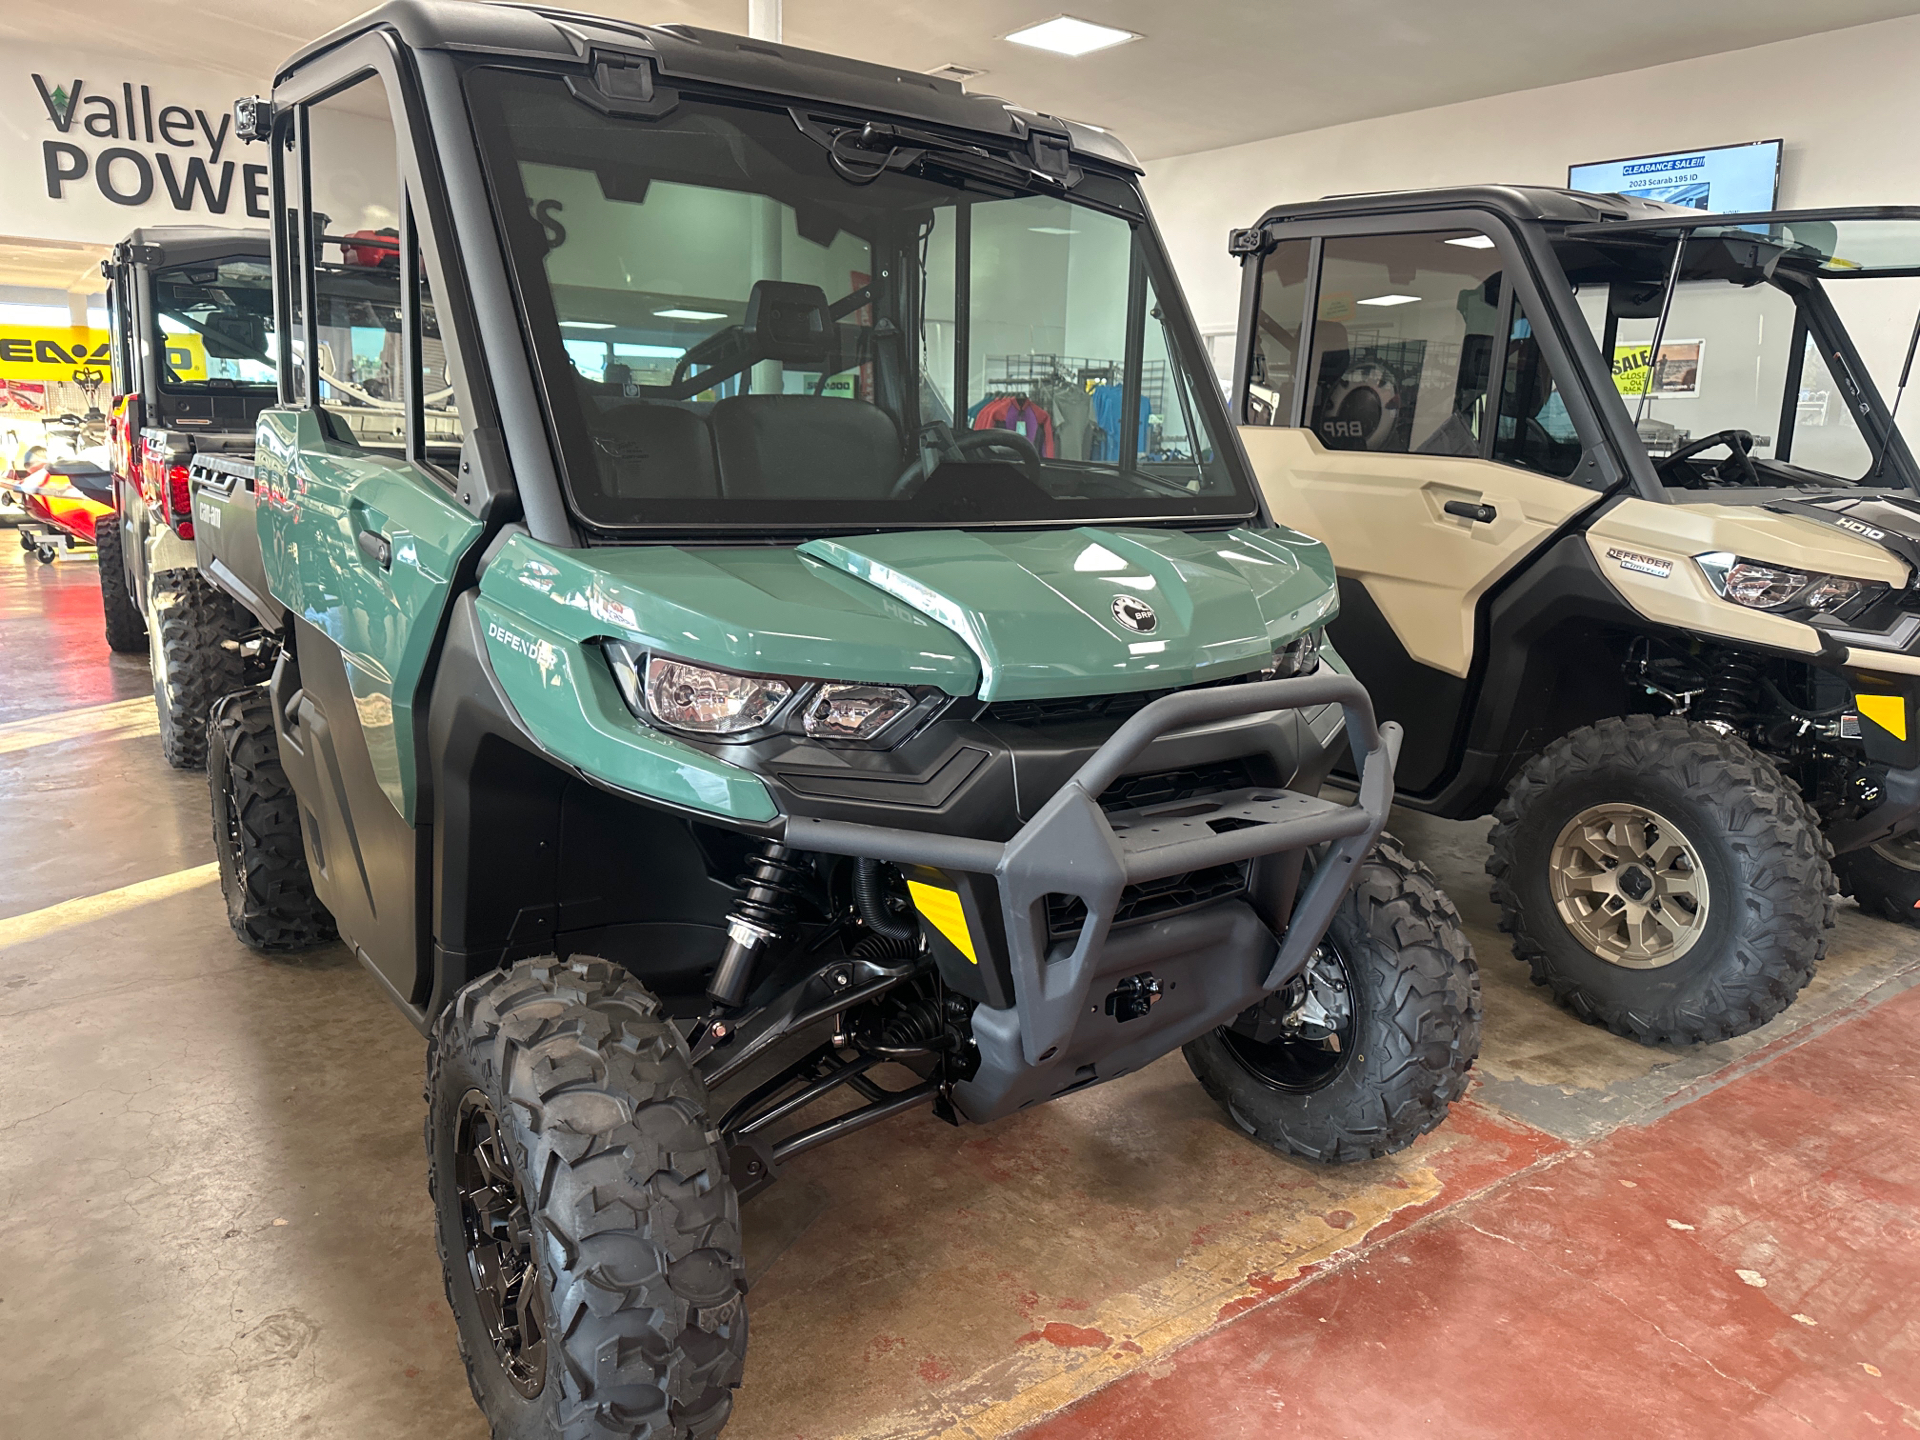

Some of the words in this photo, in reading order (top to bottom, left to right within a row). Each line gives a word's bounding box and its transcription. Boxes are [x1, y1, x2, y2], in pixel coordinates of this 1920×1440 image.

[31, 73, 231, 164] Valley
[1623, 162, 1673, 176] CLEARANCE
[1674, 156, 1706, 169] SALE!!!
[1629, 179, 1647, 188] 2023
[1648, 176, 1673, 186] Scarab
[1674, 174, 1688, 183] 195
[1689, 173, 1698, 182] ID
[1611, 350, 1650, 376] SALE
[1836, 517, 1886, 540] HD10
[1607, 547, 1672, 570] DEFENDER
[1134, 611, 1152, 620] BRP
[488, 622, 558, 670] DEFENDER
